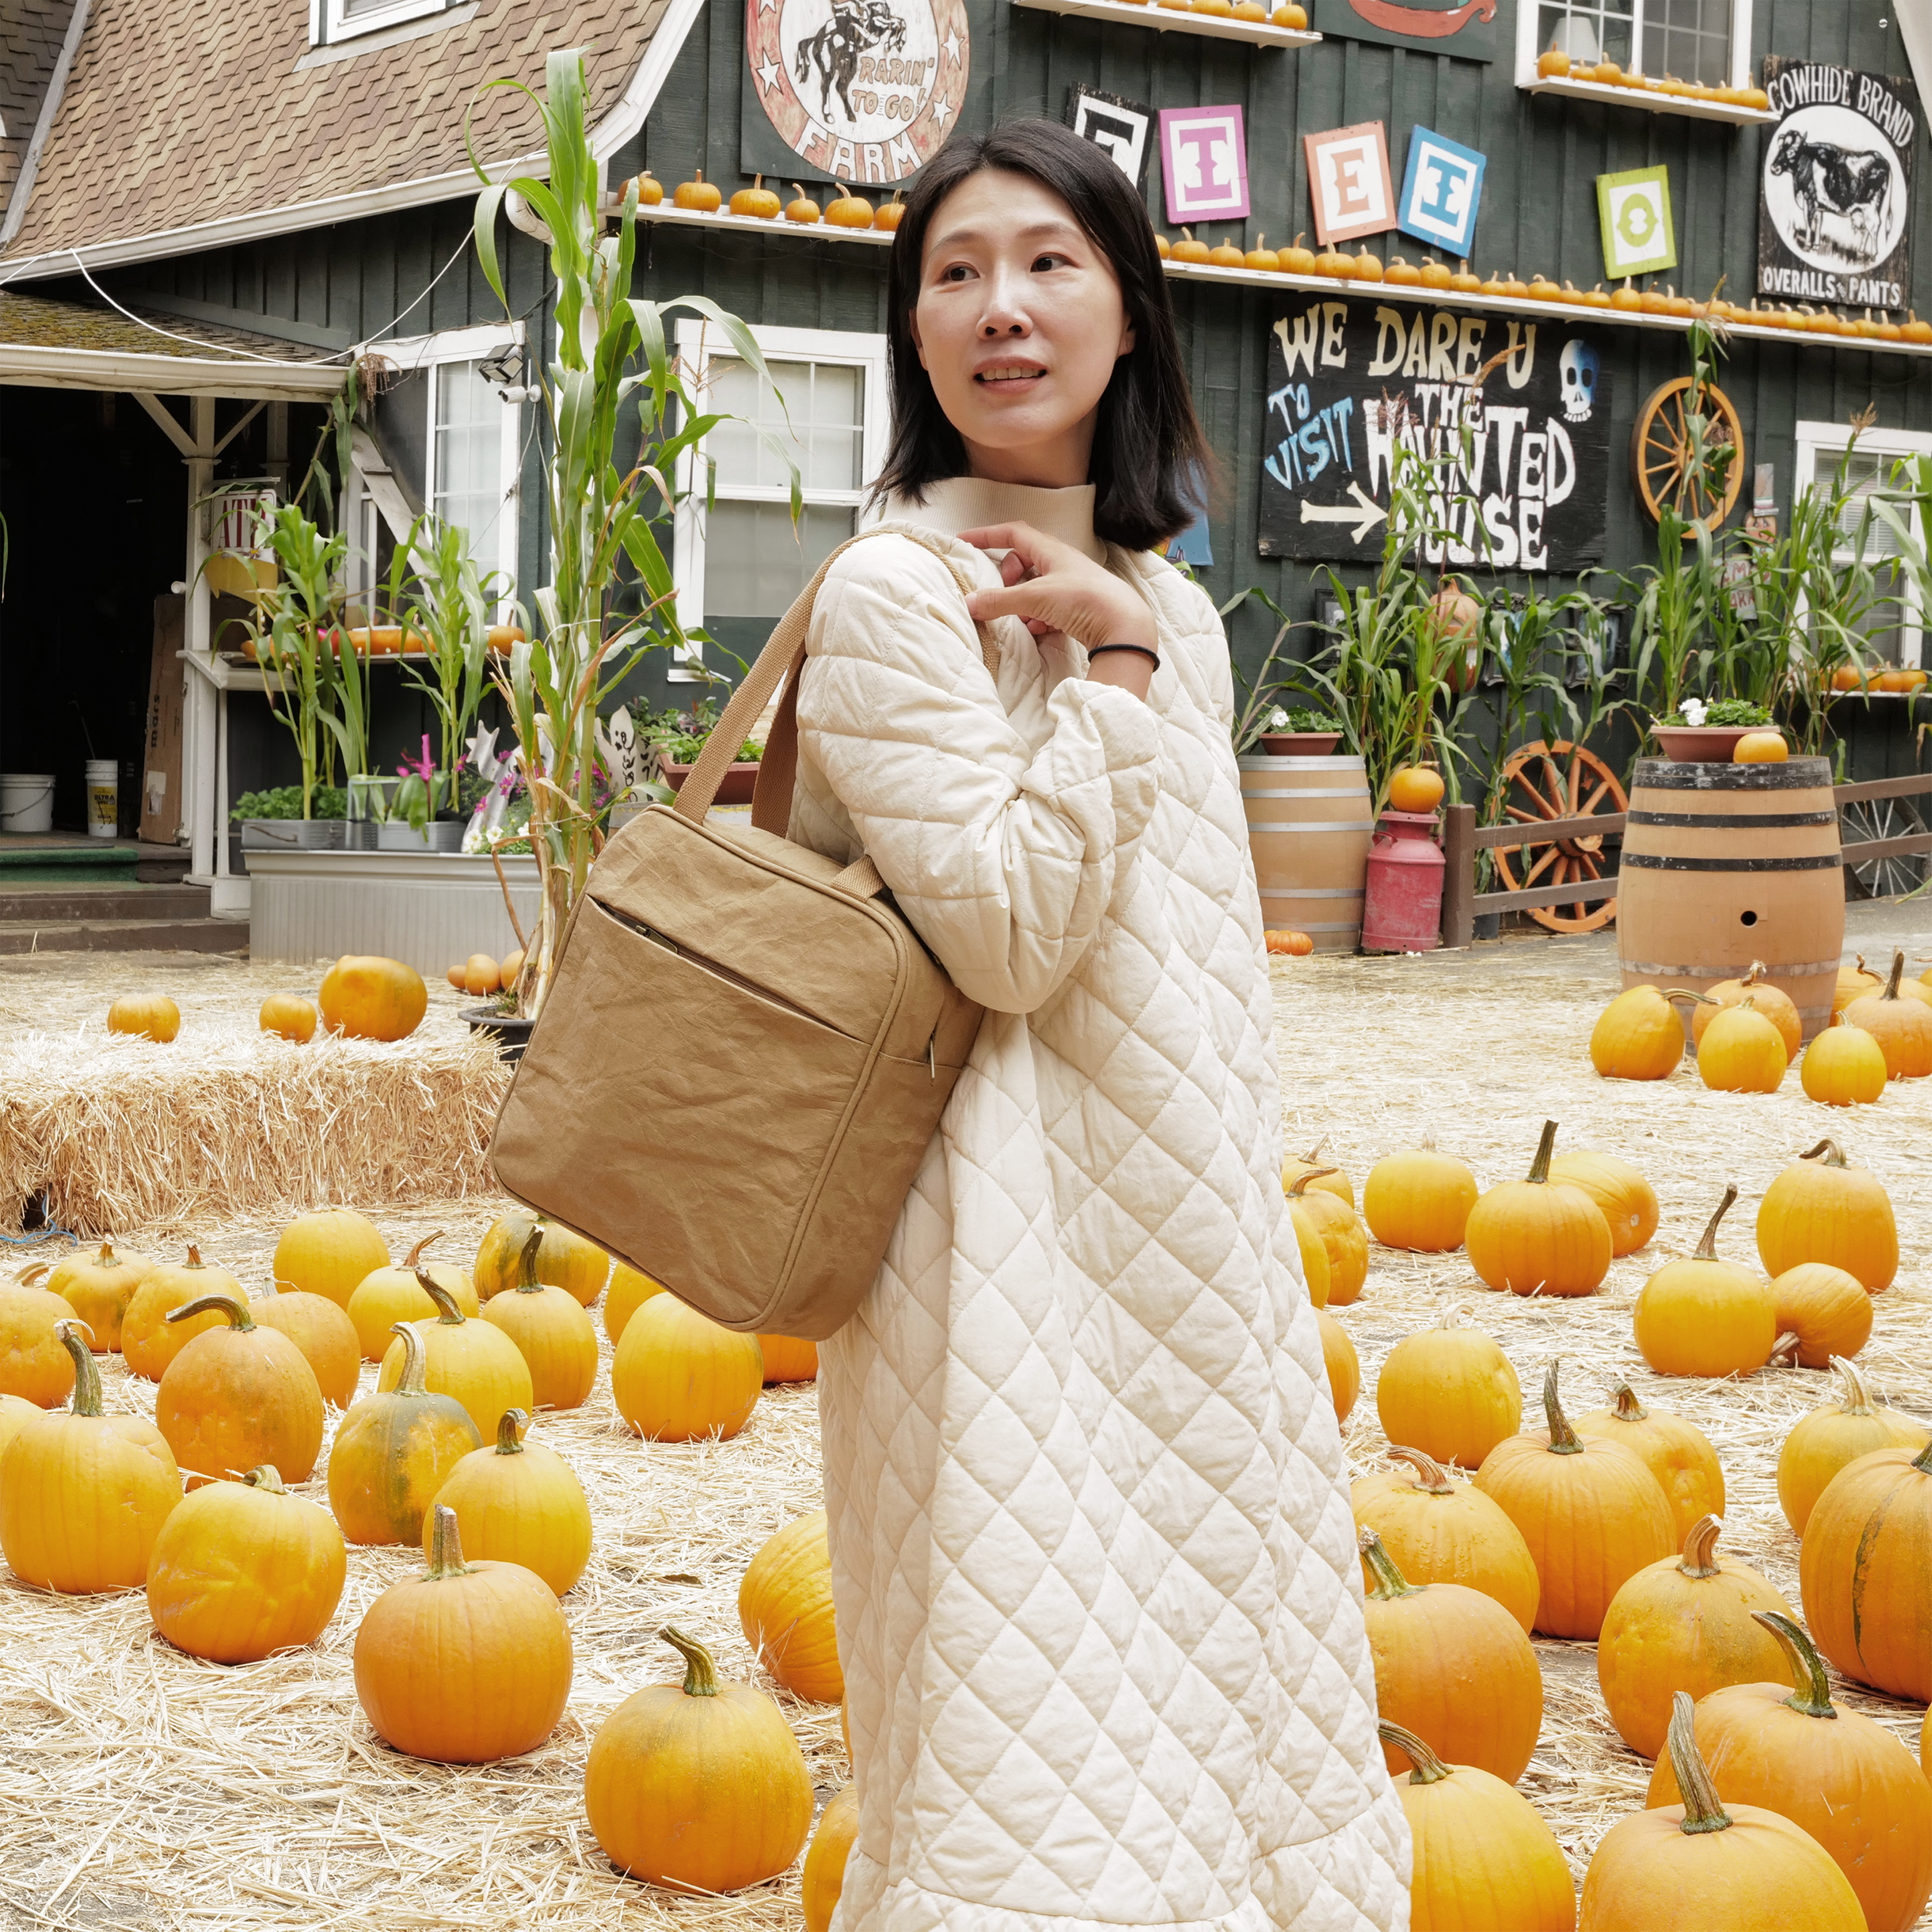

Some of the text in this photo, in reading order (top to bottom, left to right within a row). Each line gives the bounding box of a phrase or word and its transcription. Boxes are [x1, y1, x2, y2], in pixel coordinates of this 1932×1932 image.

[859, 56, 935, 86] RARIN'
[851, 87, 926, 122] TO GO!
[1767, 65, 1915, 147] COWHIDE BRAND
[793, 118, 923, 184] FARM
[1763, 267, 1836, 299] OVERALLS
[1849, 277, 1901, 306] PANTS
[1273, 303, 1537, 390] WE DARE U
[1268, 383, 1310, 434] TO
[1414, 383, 1484, 433] THE
[1263, 396, 1354, 491] VISIT
[1362, 398, 1576, 508] HAUNTED
